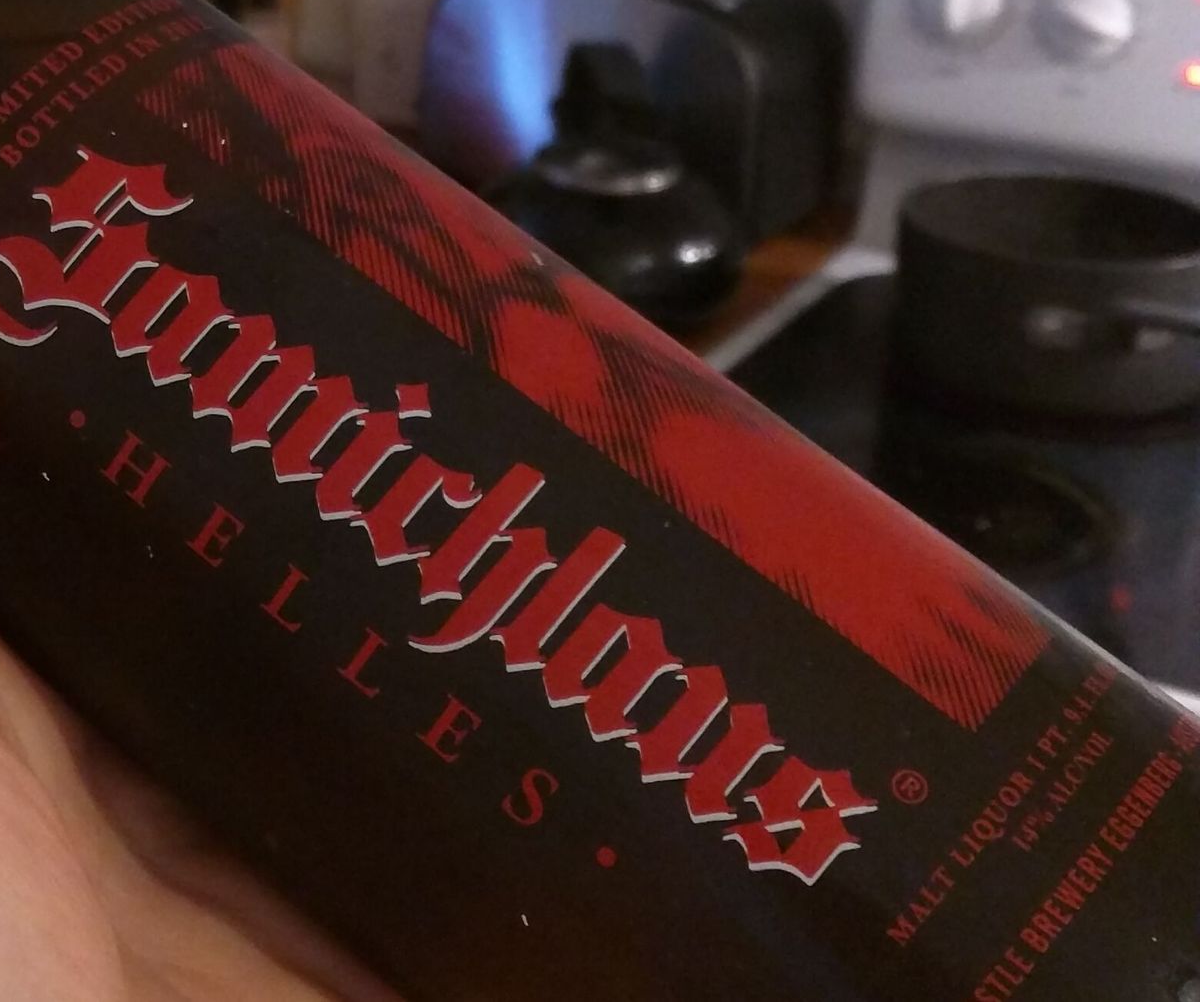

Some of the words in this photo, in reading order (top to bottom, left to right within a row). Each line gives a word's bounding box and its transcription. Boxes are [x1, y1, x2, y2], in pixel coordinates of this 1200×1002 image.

[100, 430, 560, 827] HELLES
[886, 865, 955, 946] MALT
[949, 770, 1033, 868] LIQUOR
[1020, 843, 1115, 954] BREWERY
[1100, 750, 1183, 853] EGGENBERG
